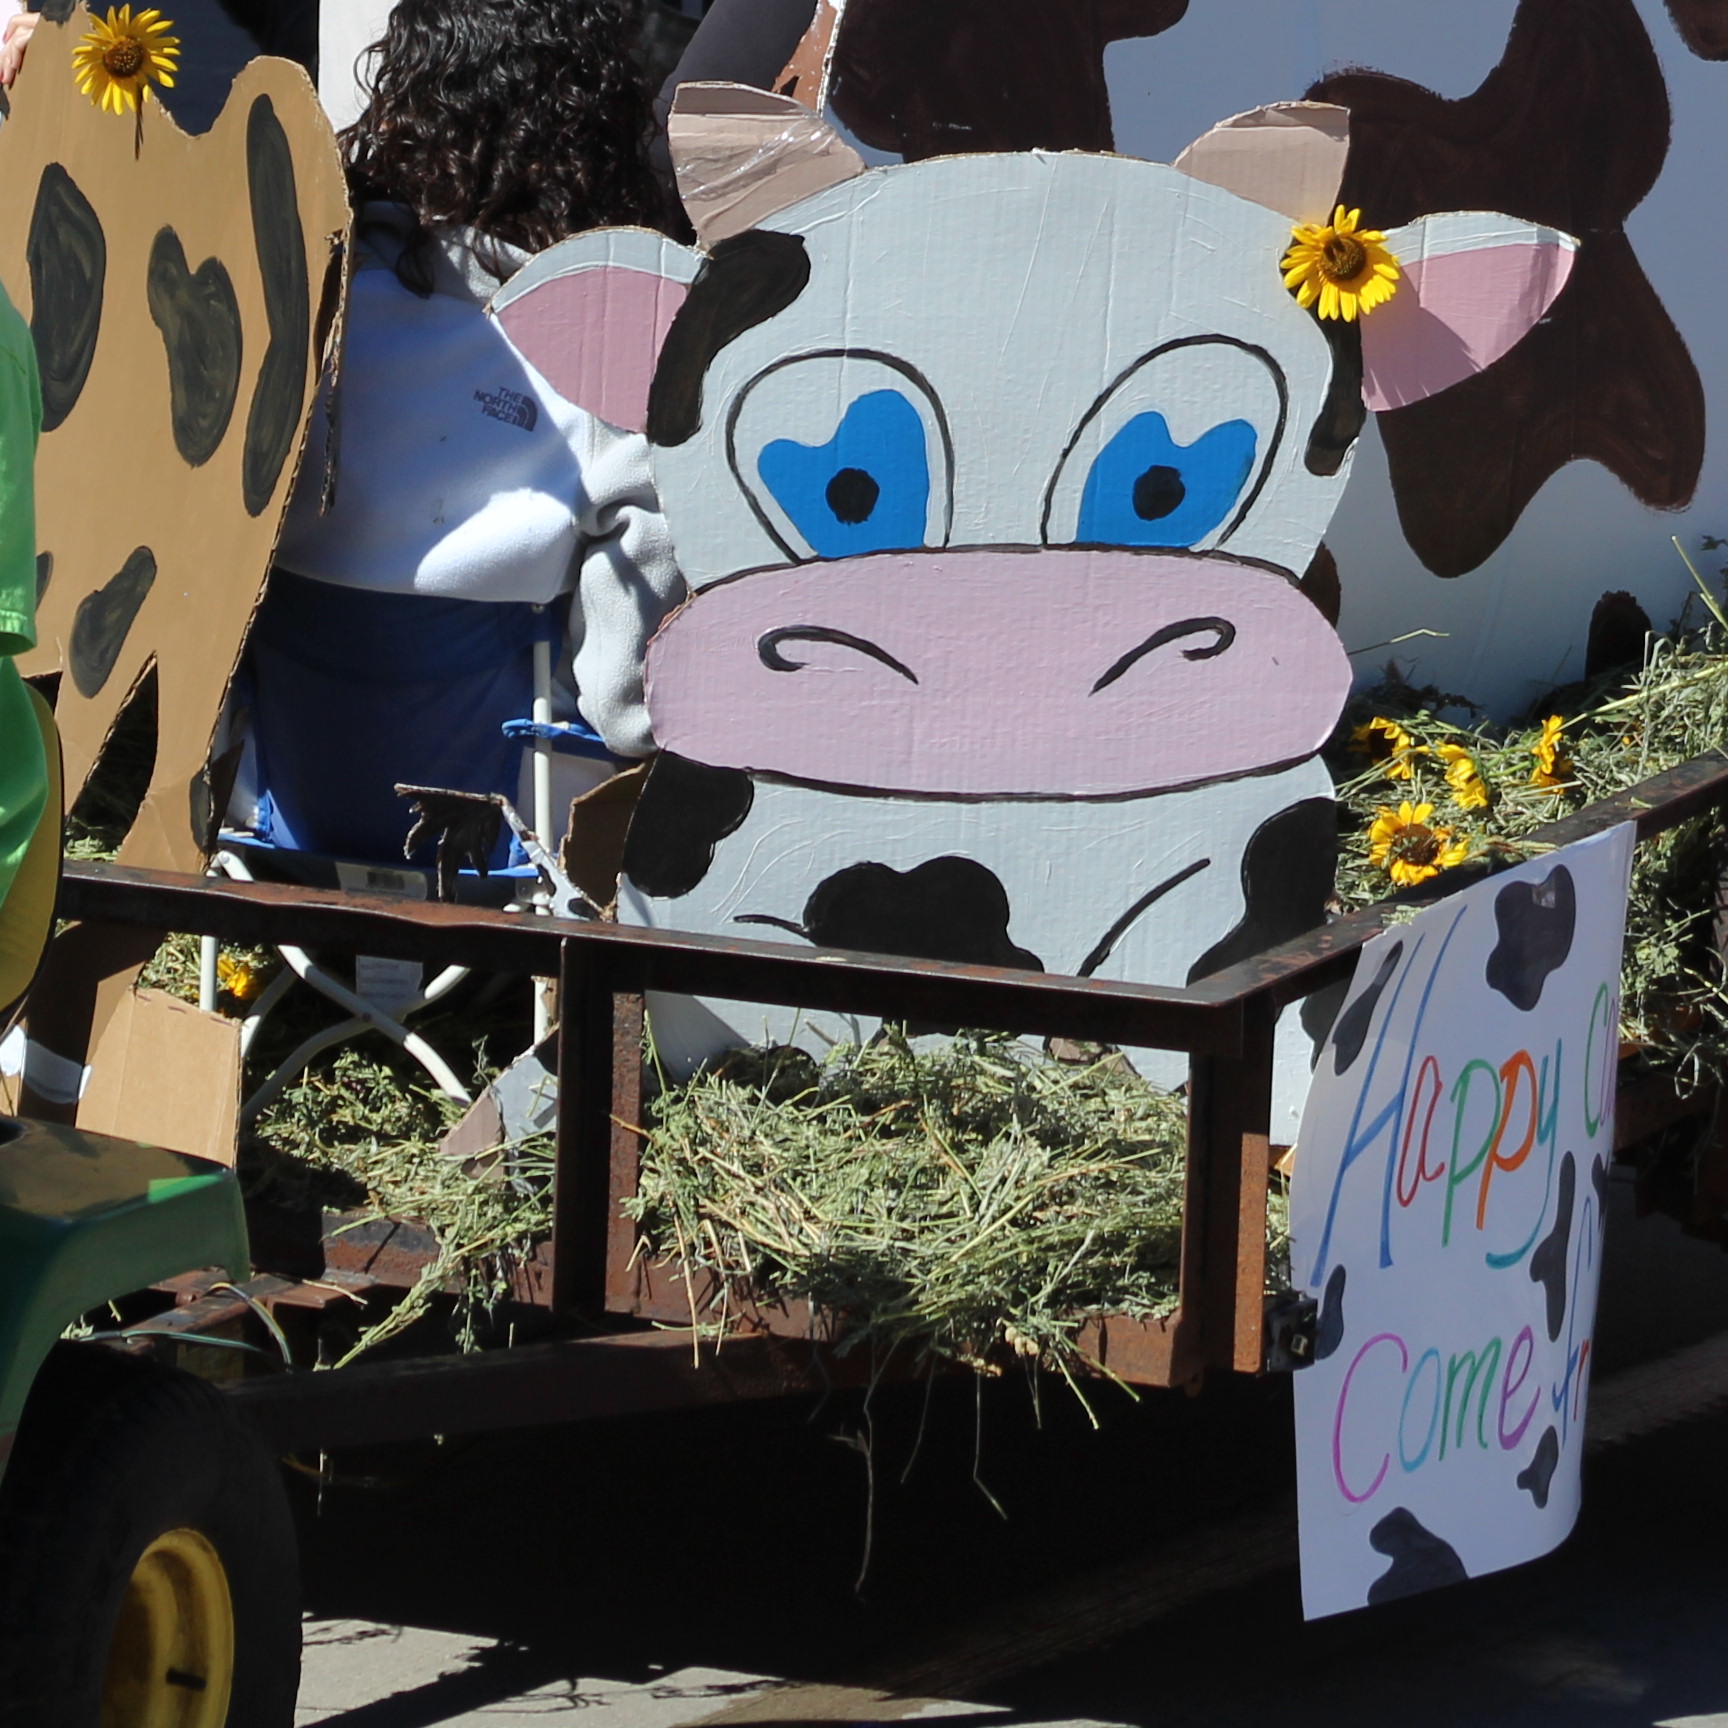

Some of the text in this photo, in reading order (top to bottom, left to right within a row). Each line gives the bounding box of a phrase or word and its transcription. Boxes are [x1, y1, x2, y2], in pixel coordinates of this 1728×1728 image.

[1309, 904, 1562, 1290] Happy
[1330, 1195, 1592, 1506] Come fr
